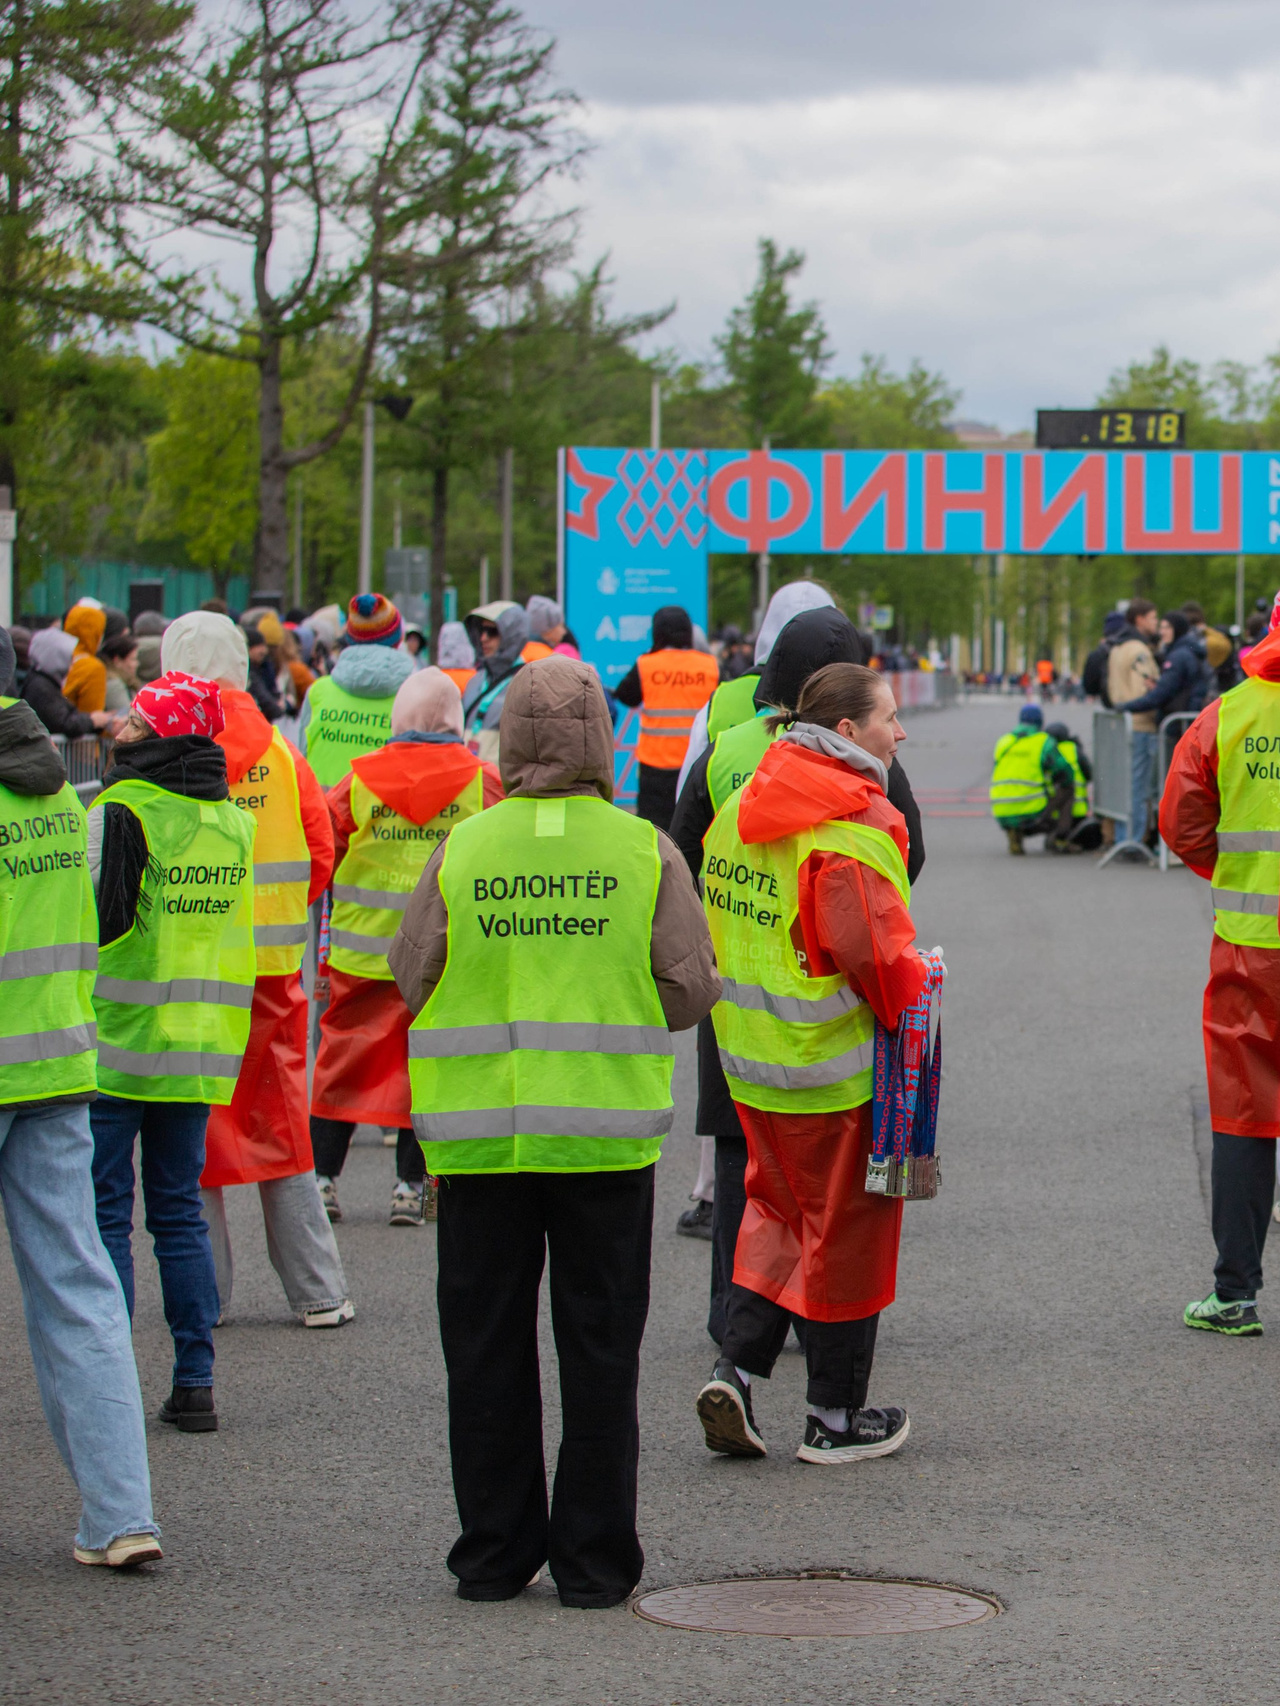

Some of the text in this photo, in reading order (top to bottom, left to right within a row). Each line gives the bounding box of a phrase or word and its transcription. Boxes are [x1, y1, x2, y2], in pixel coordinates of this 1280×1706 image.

[707, 449, 1242, 553] ФИНИШ
[651, 669, 706, 688] СУДЬЯ
[474, 870, 619, 901] ВОЛОНТЁР
[477, 911, 610, 939] Volunteer
[875, 1094, 890, 1155] MOSCOW
[893, 1111, 905, 1164] OSCOW
